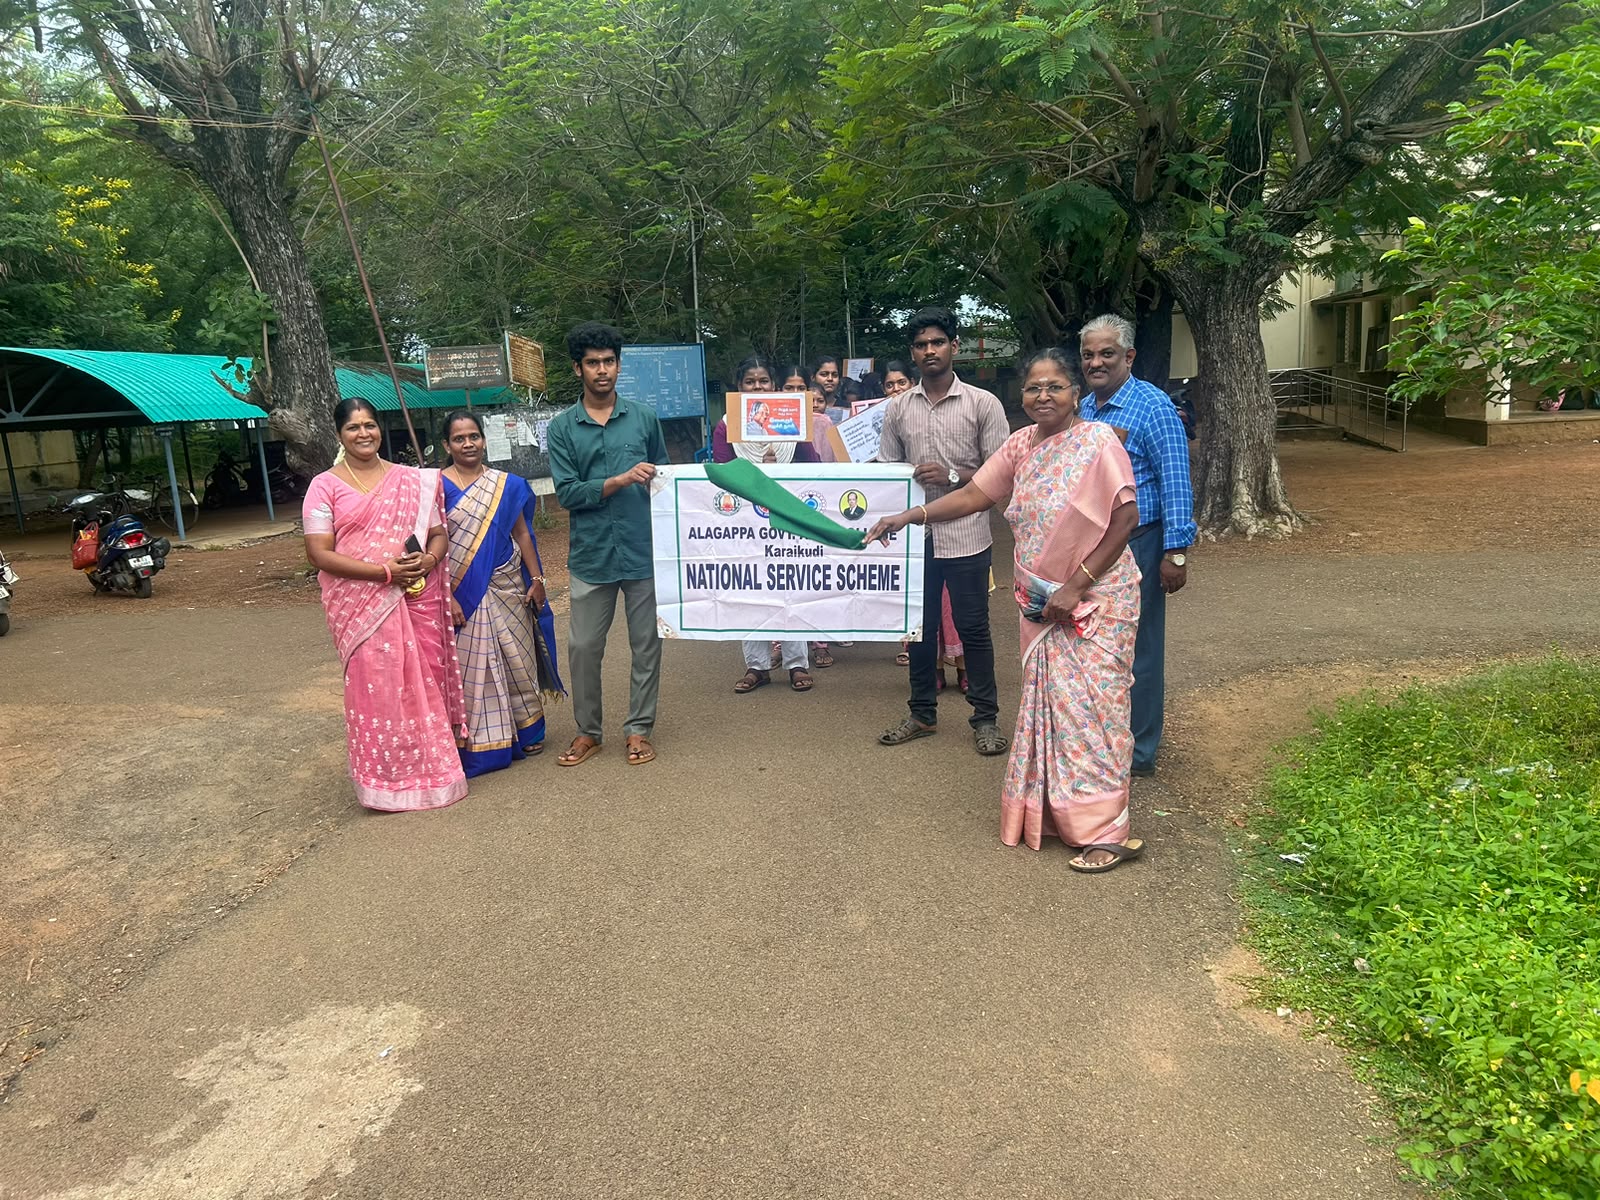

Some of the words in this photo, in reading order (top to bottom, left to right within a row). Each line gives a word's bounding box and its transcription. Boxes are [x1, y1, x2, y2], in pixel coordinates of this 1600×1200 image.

[688, 526, 756, 540] ALAGAPPA
[764, 544, 824, 558] Karaikudi
[686, 563, 763, 591] NATIONAL
[766, 563, 832, 591] SERVICE
[836, 563, 901, 592] SCHEME
